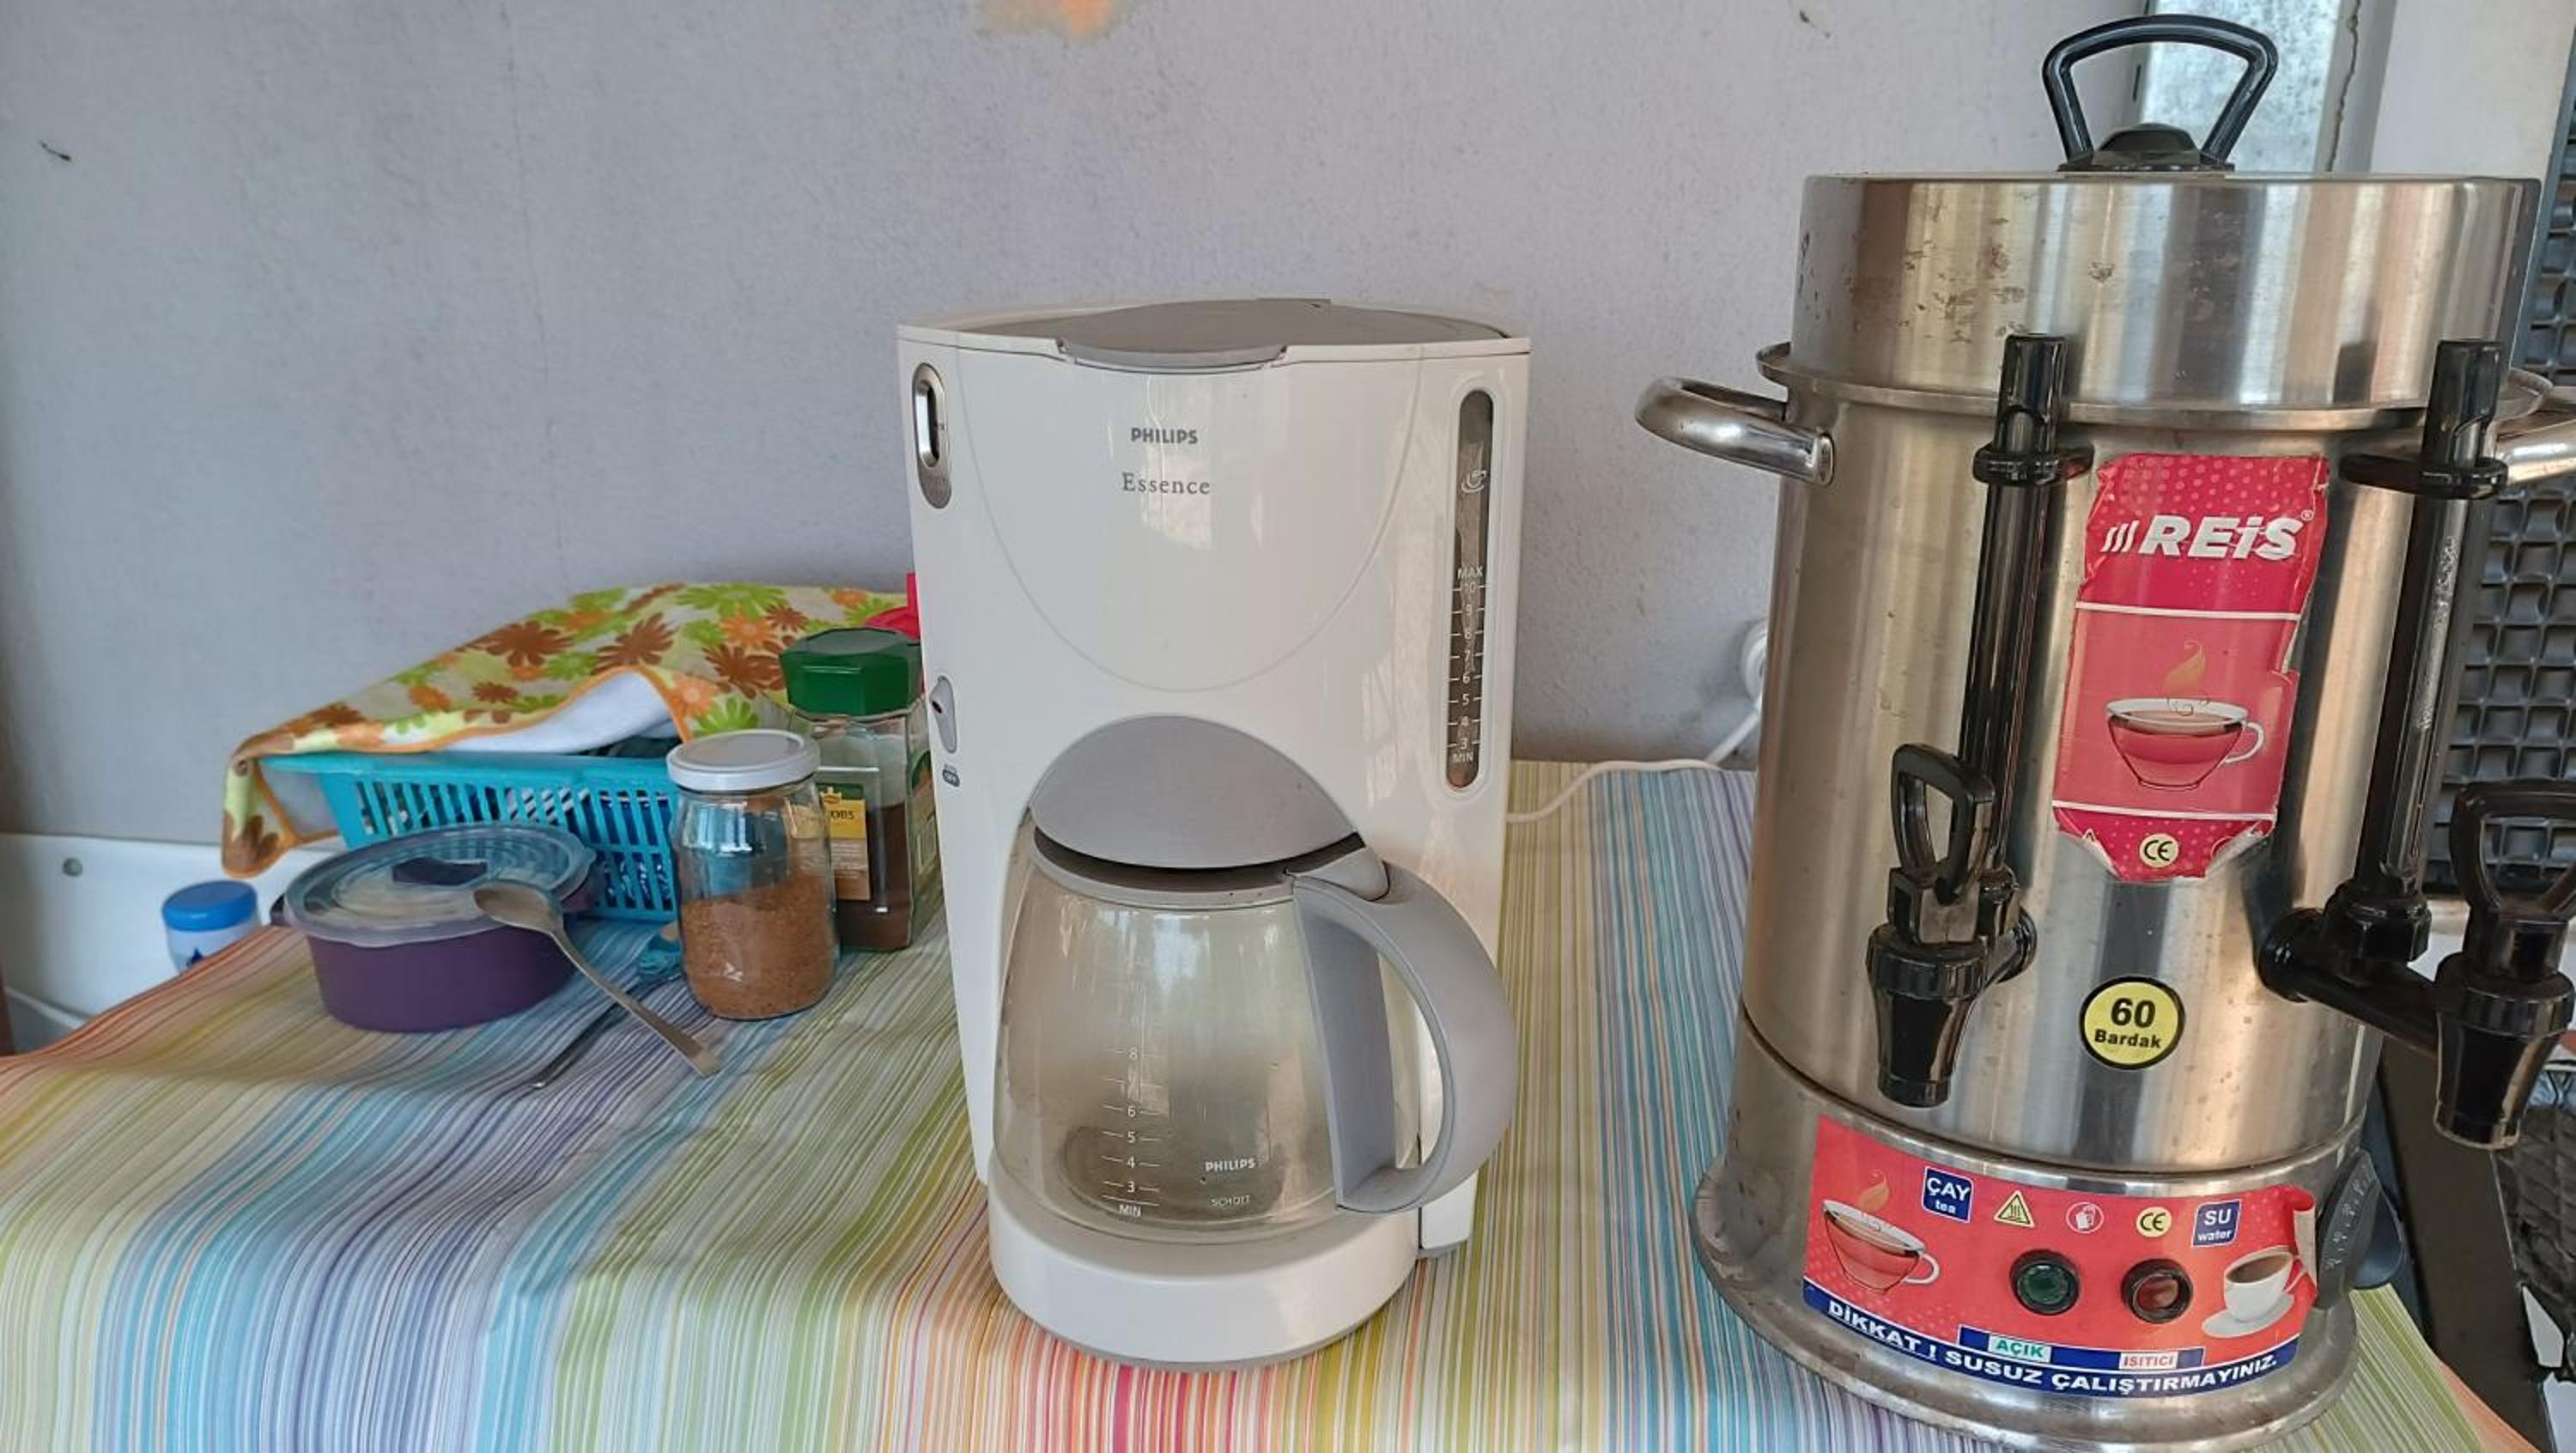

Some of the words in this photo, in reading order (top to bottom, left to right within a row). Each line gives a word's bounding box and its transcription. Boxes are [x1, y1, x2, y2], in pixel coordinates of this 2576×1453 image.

[1130, 427, 1199, 444] PHILIPS
[1121, 471, 1210, 495] Essence
[1457, 566, 1483, 580] MAX
[1463, 649, 1471, 662] 7
[1462, 672, 1471, 684] 6
[1461, 694, 1470, 706] 5
[1461, 715, 1469, 727] 4
[1460, 738, 1468, 750] 3
[2143, 839, 2174, 861] CE
[2111, 998, 2156, 1028] 60
[2094, 1028, 2162, 1049] Bardak
[1127, 1047, 1138, 1061] 8
[1127, 1105, 1136, 1117] 6
[1127, 1131, 1136, 1143] 5
[1127, 1156, 1136, 1168] 4
[1205, 1158, 1256, 1171] PHILIPS
[1127, 1181, 1135, 1193] 3
[1927, 1177, 1971, 1201] ÇAY
[1119, 1204, 1141, 1217] MIN
[1935, 1199, 1956, 1213] tea
[2140, 1212, 2166, 1231] CE
[2203, 1208, 2232, 1225] SU
[2198, 1230, 2233, 1242] water
[1996, 1339, 2044, 1359] AÇIK
[1945, 1351, 2044, 1384] SUSUZ
